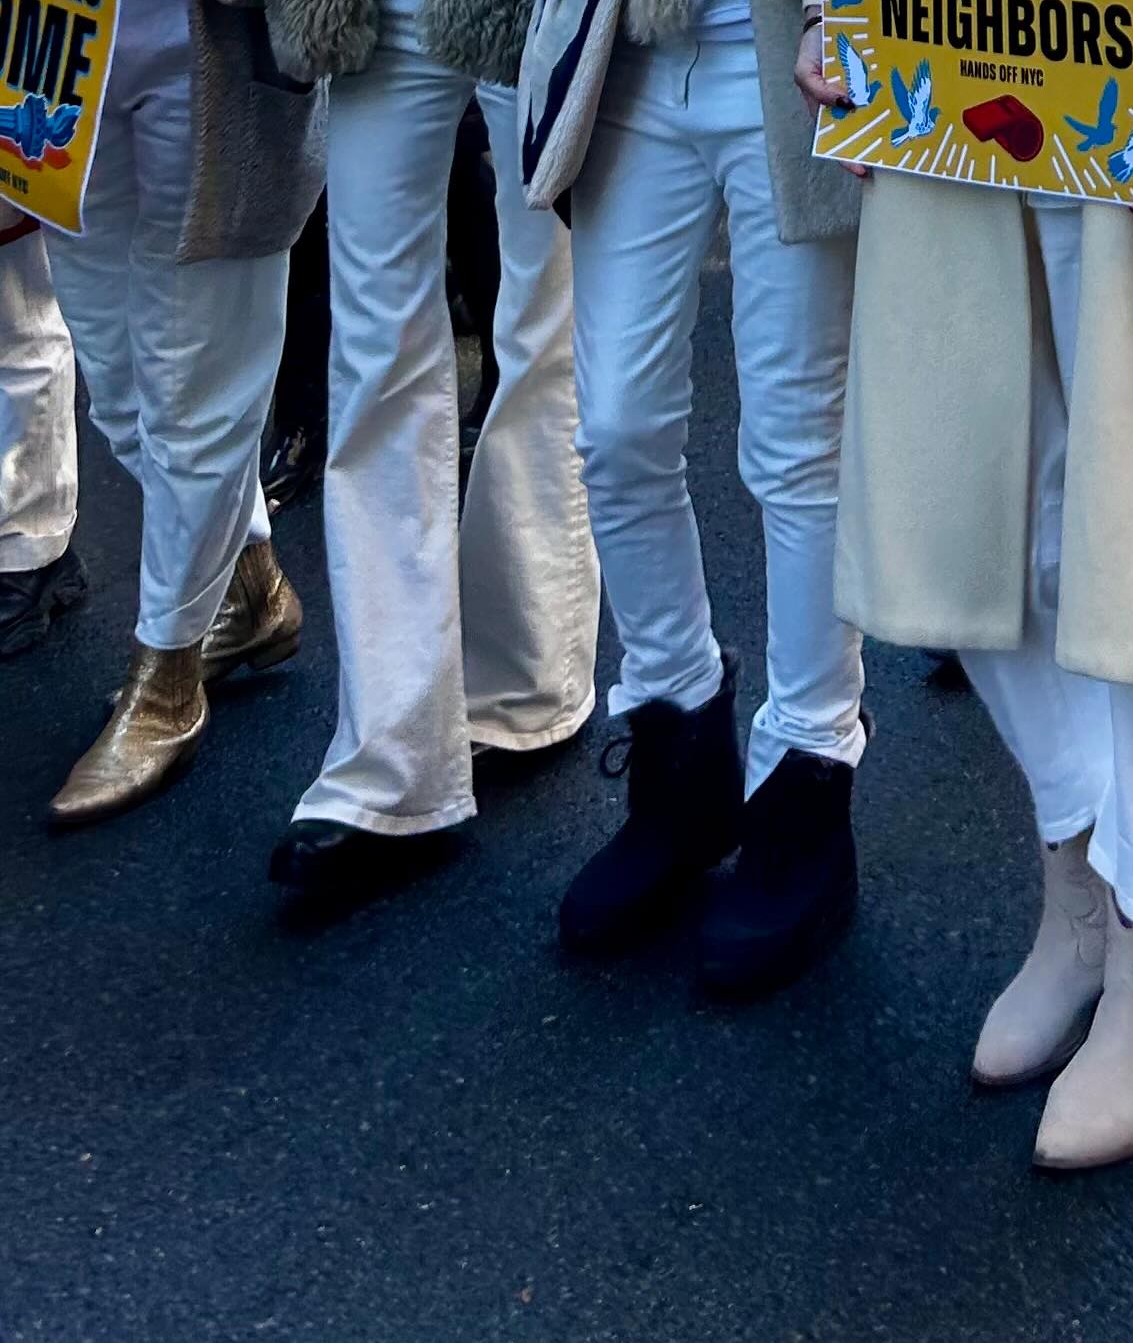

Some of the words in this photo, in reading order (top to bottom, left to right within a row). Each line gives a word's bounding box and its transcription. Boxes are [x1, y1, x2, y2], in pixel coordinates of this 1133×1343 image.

[960, 58, 997, 81] HANDS
[999, 64, 1018, 84] OFF
[1020, 67, 1044, 87] NYC
